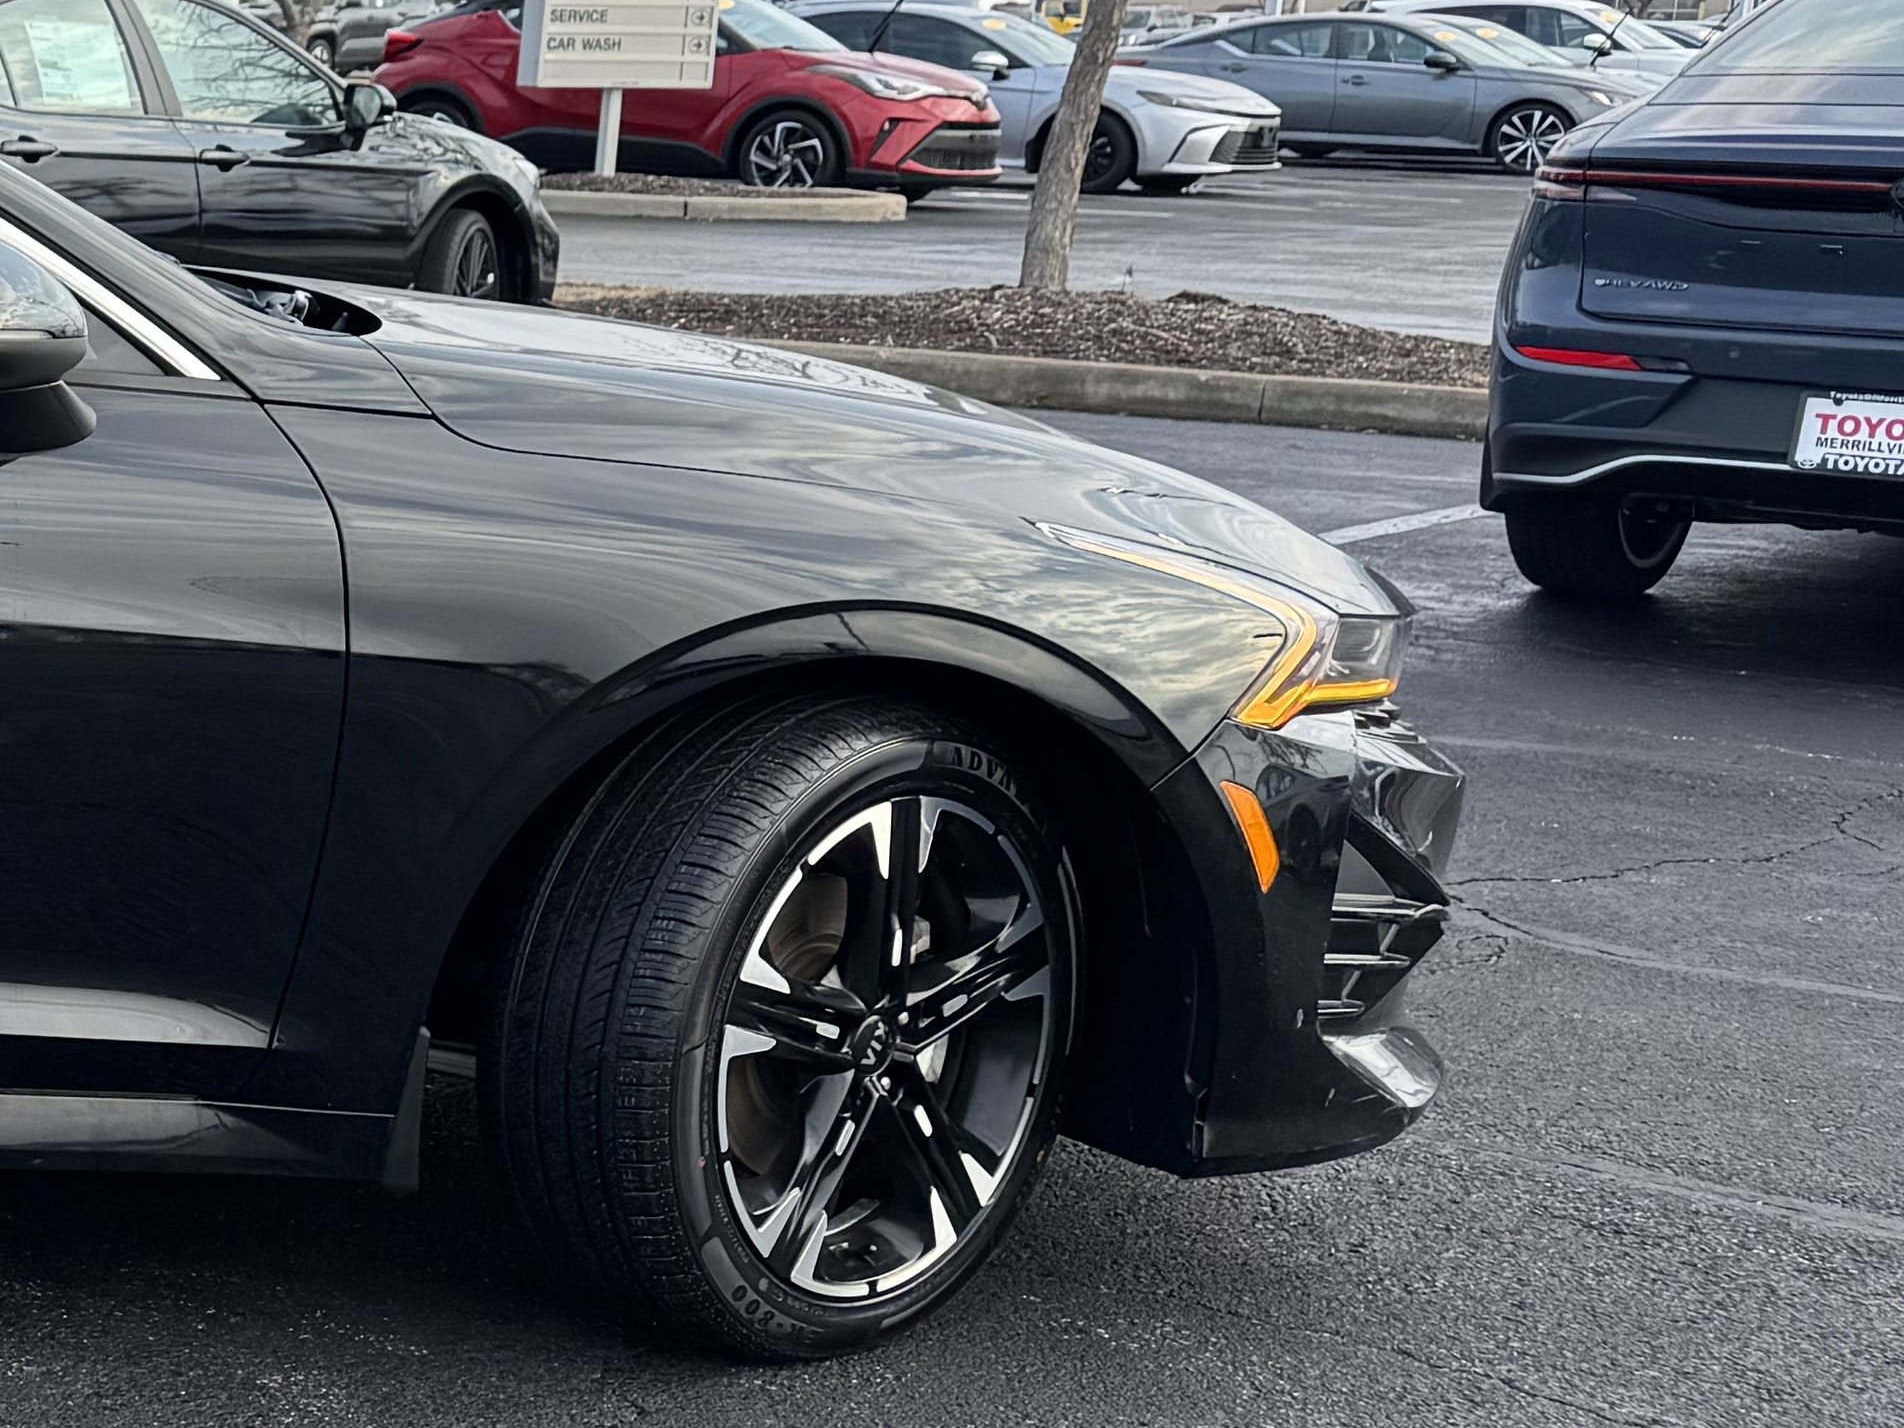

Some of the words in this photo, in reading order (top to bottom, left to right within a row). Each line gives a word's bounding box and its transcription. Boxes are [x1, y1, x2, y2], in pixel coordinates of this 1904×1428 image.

[549, 8, 608, 24] SERVICE
[546, 36, 576, 51] CAR
[581, 37, 622, 52] WASH
[1815, 436, 1904, 456] MERRILLVI
